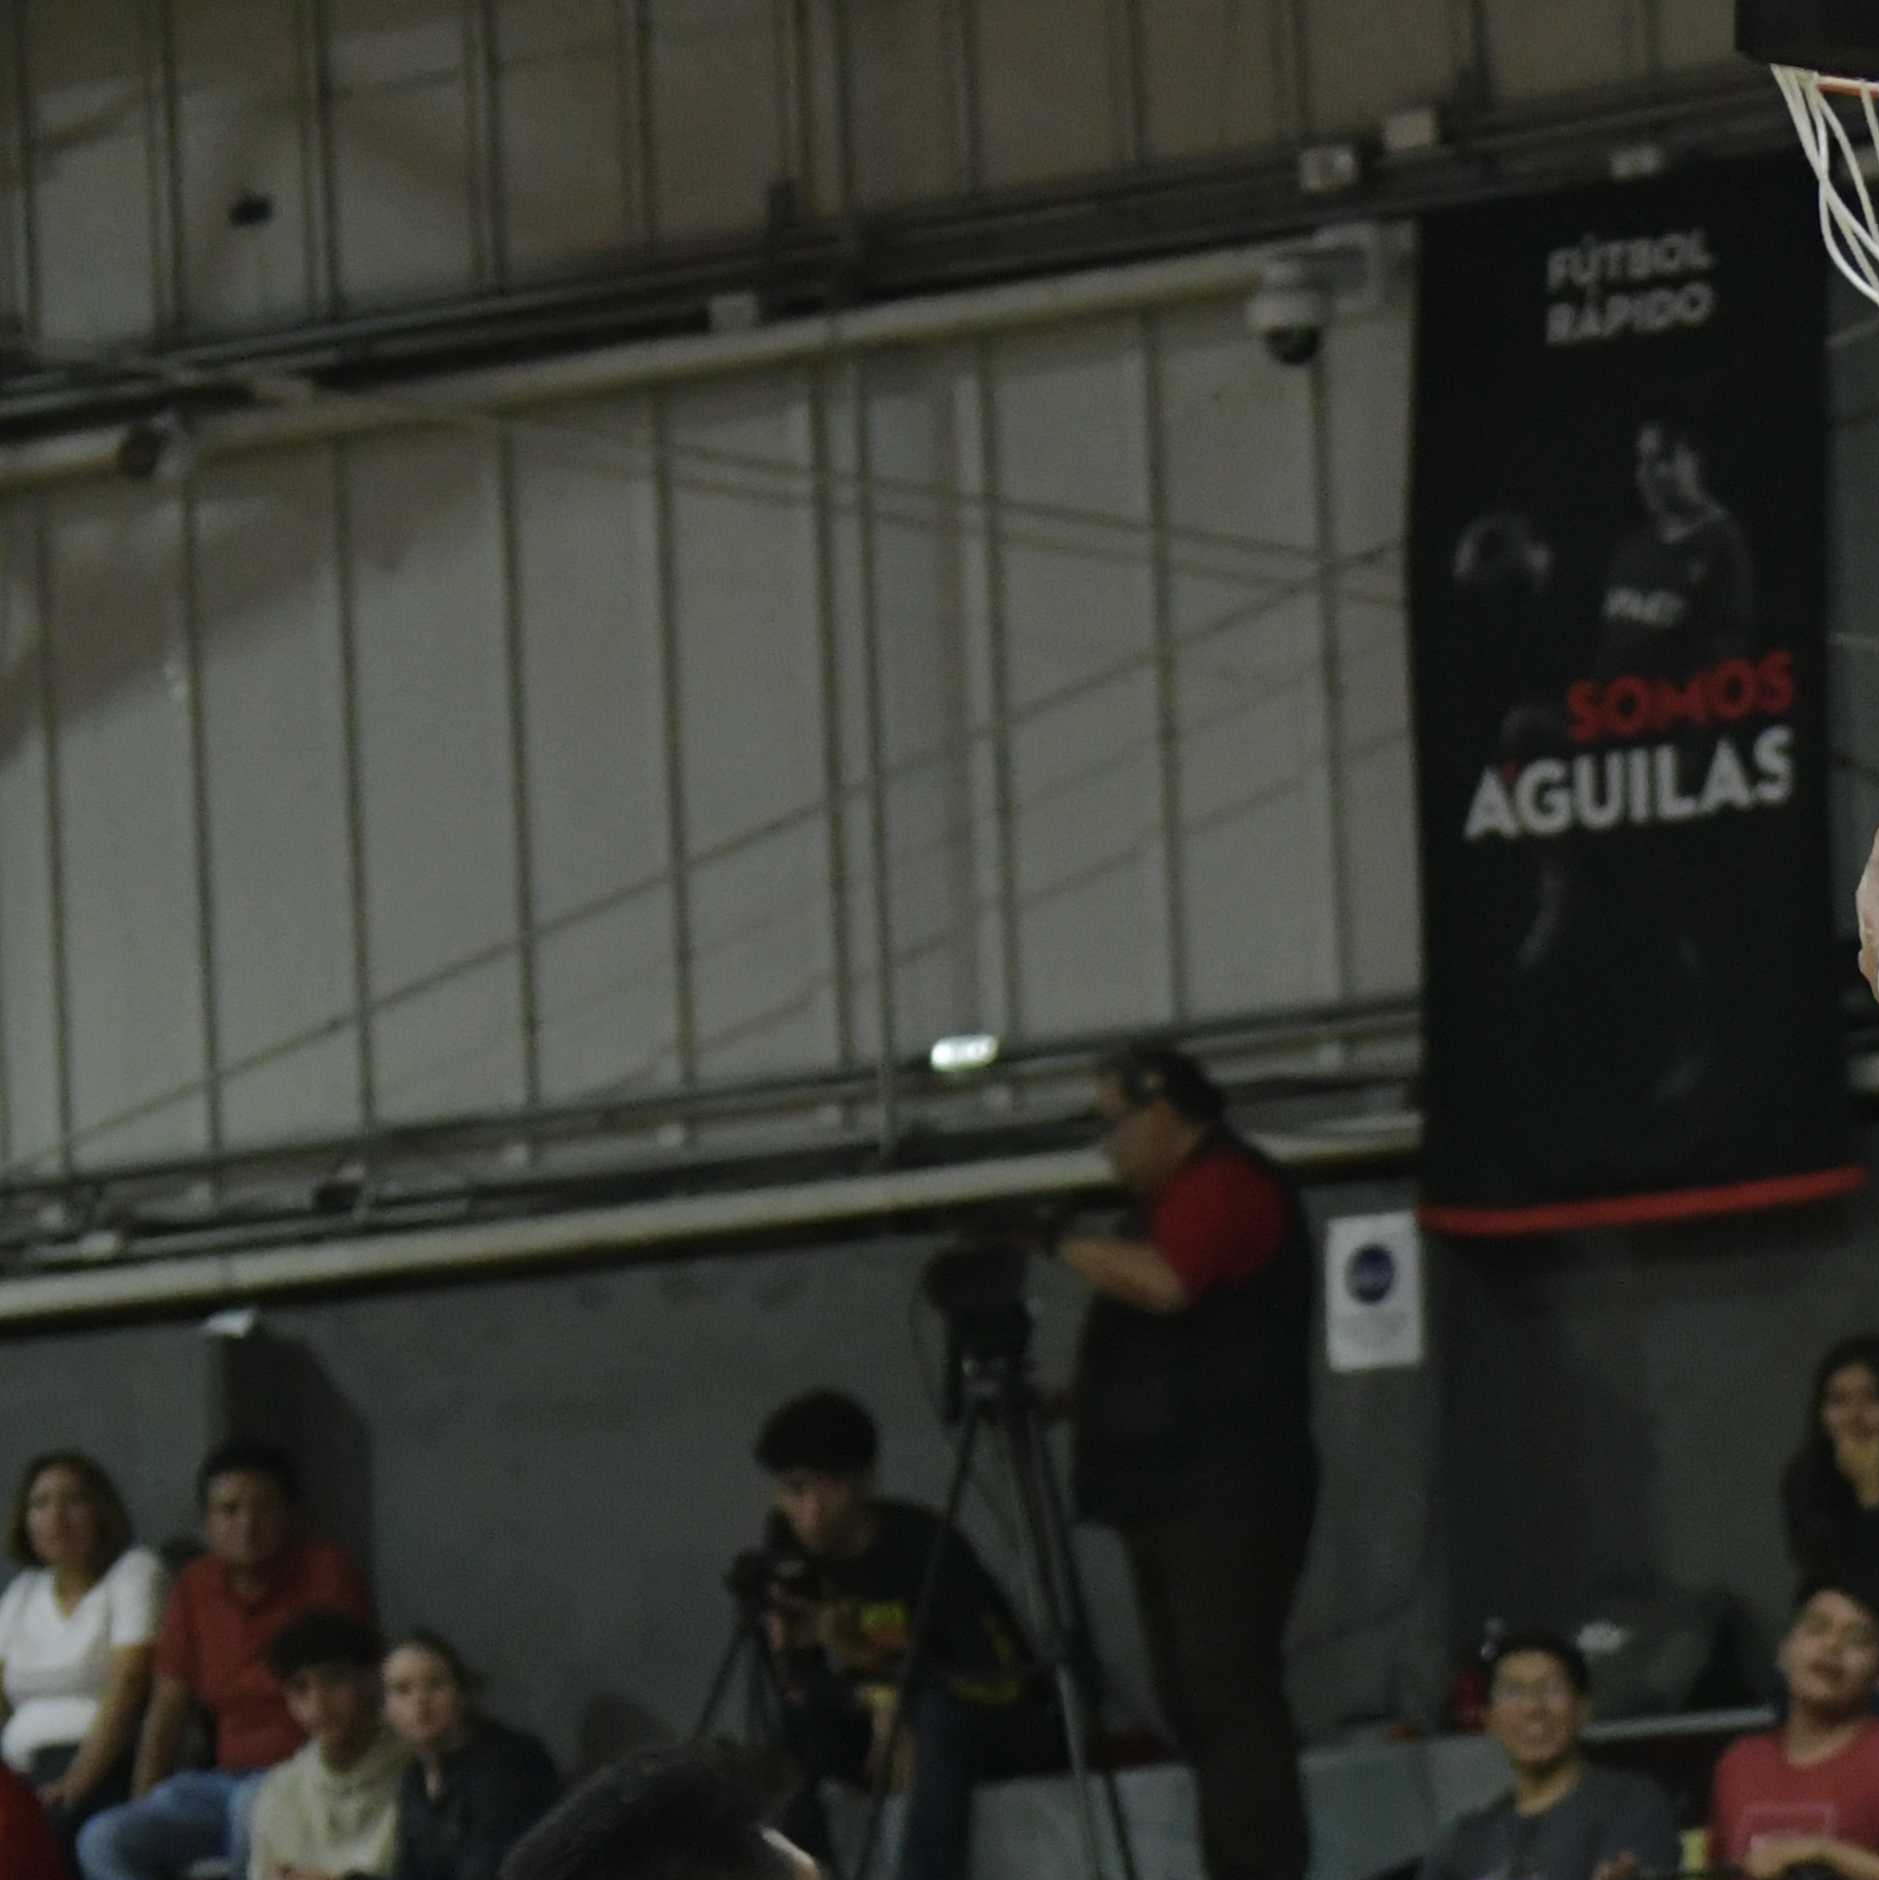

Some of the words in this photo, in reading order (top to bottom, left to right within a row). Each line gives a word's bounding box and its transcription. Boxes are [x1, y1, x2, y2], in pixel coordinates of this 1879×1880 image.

[1545, 229, 1718, 293] FÚTBOL
[1545, 280, 1717, 347] RÁPIDO
[1566, 647, 1796, 745] SOMOS
